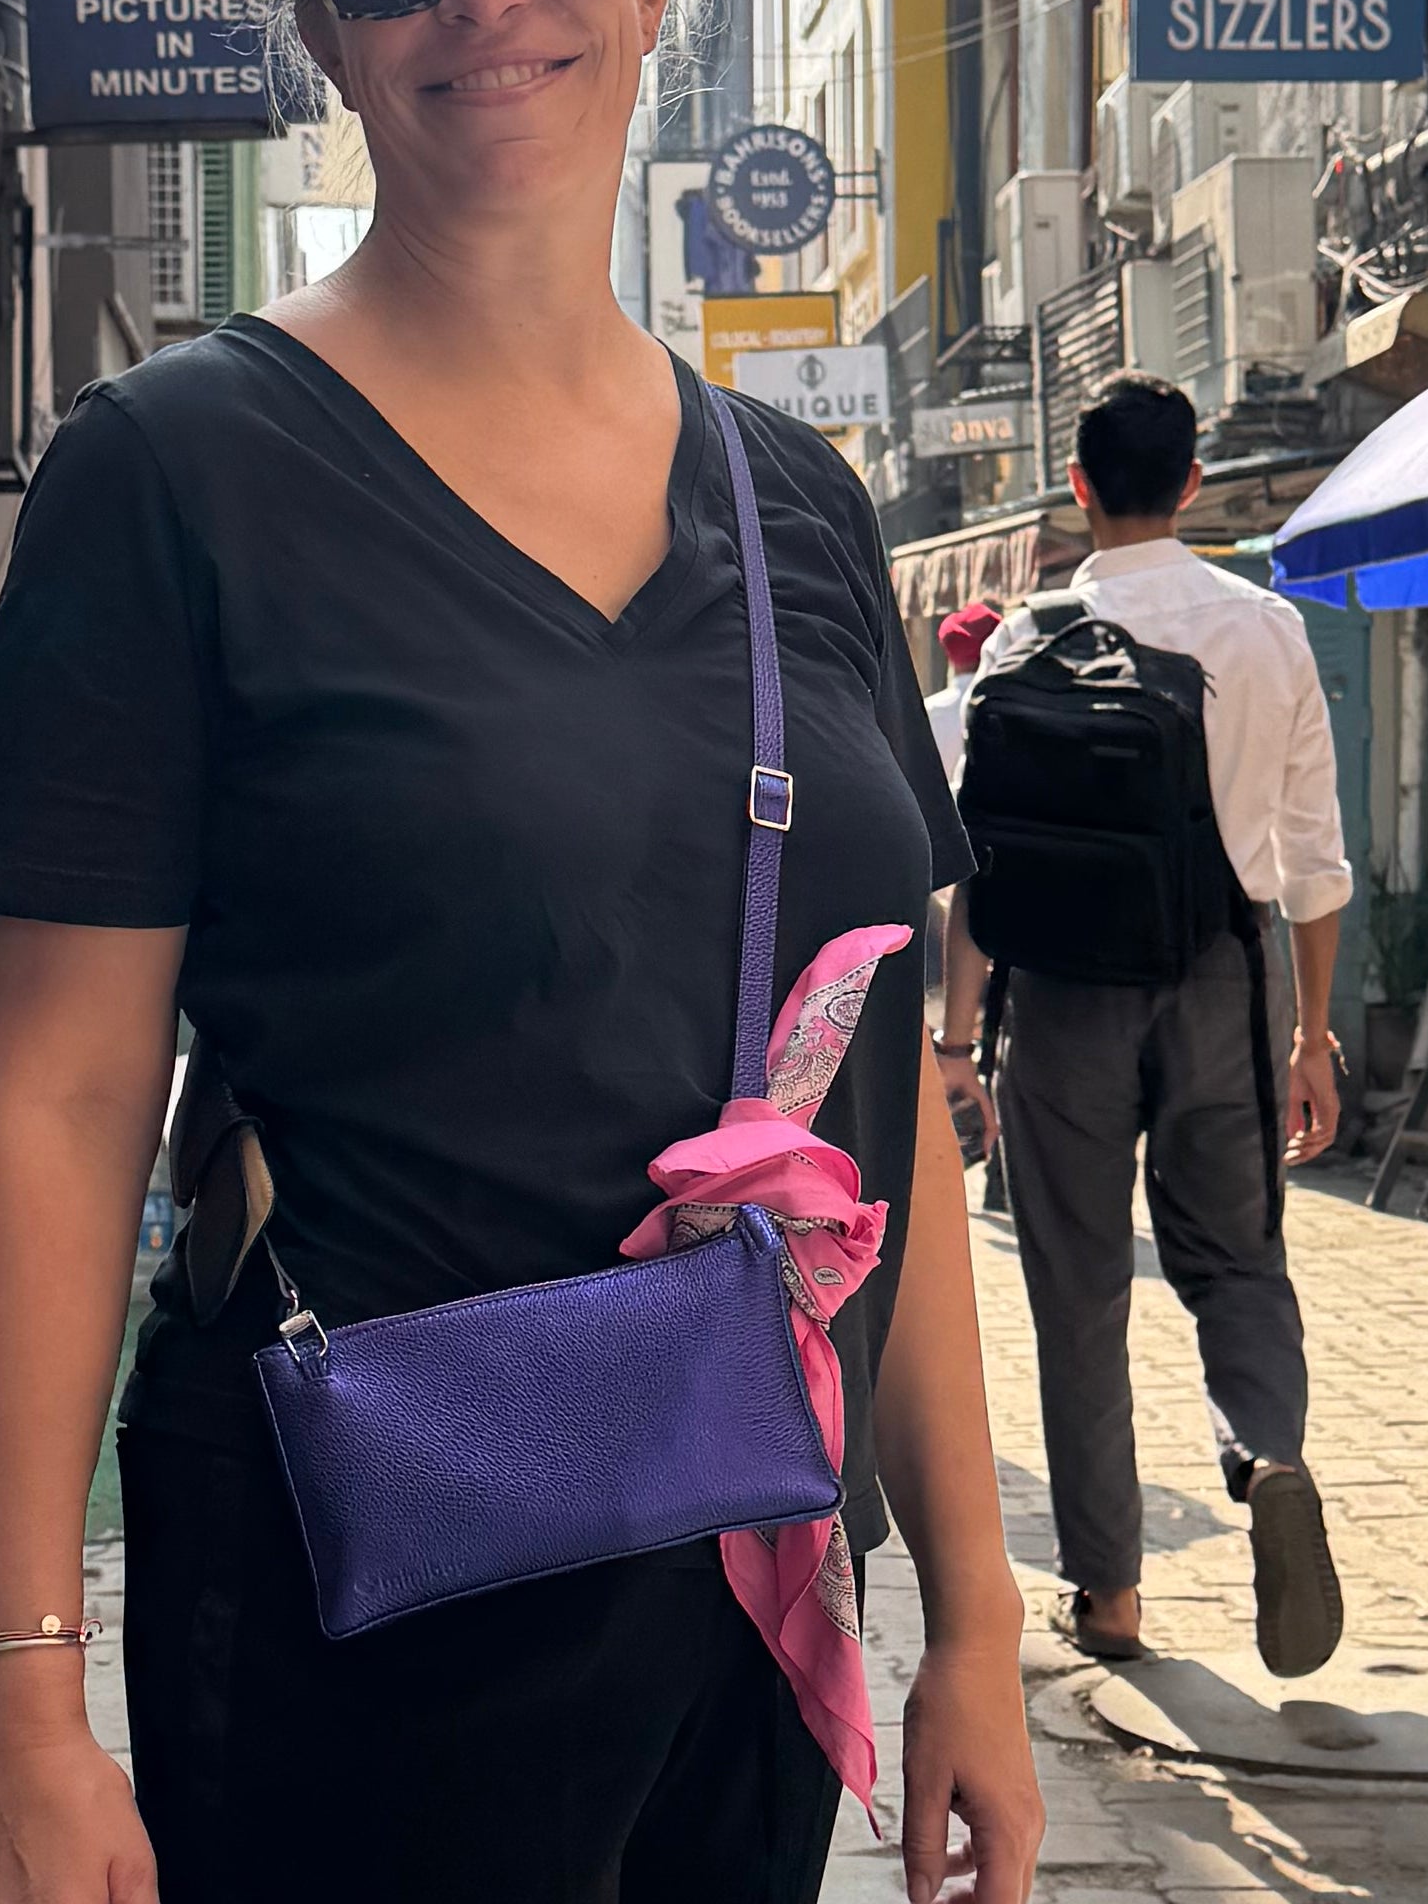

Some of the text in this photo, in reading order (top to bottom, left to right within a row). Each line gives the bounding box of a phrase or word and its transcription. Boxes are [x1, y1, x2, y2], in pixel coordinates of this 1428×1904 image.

[155, 30, 195, 59] IN
[89, 65, 264, 98] MINUTES
[714, 130, 829, 187] BAHRISONS
